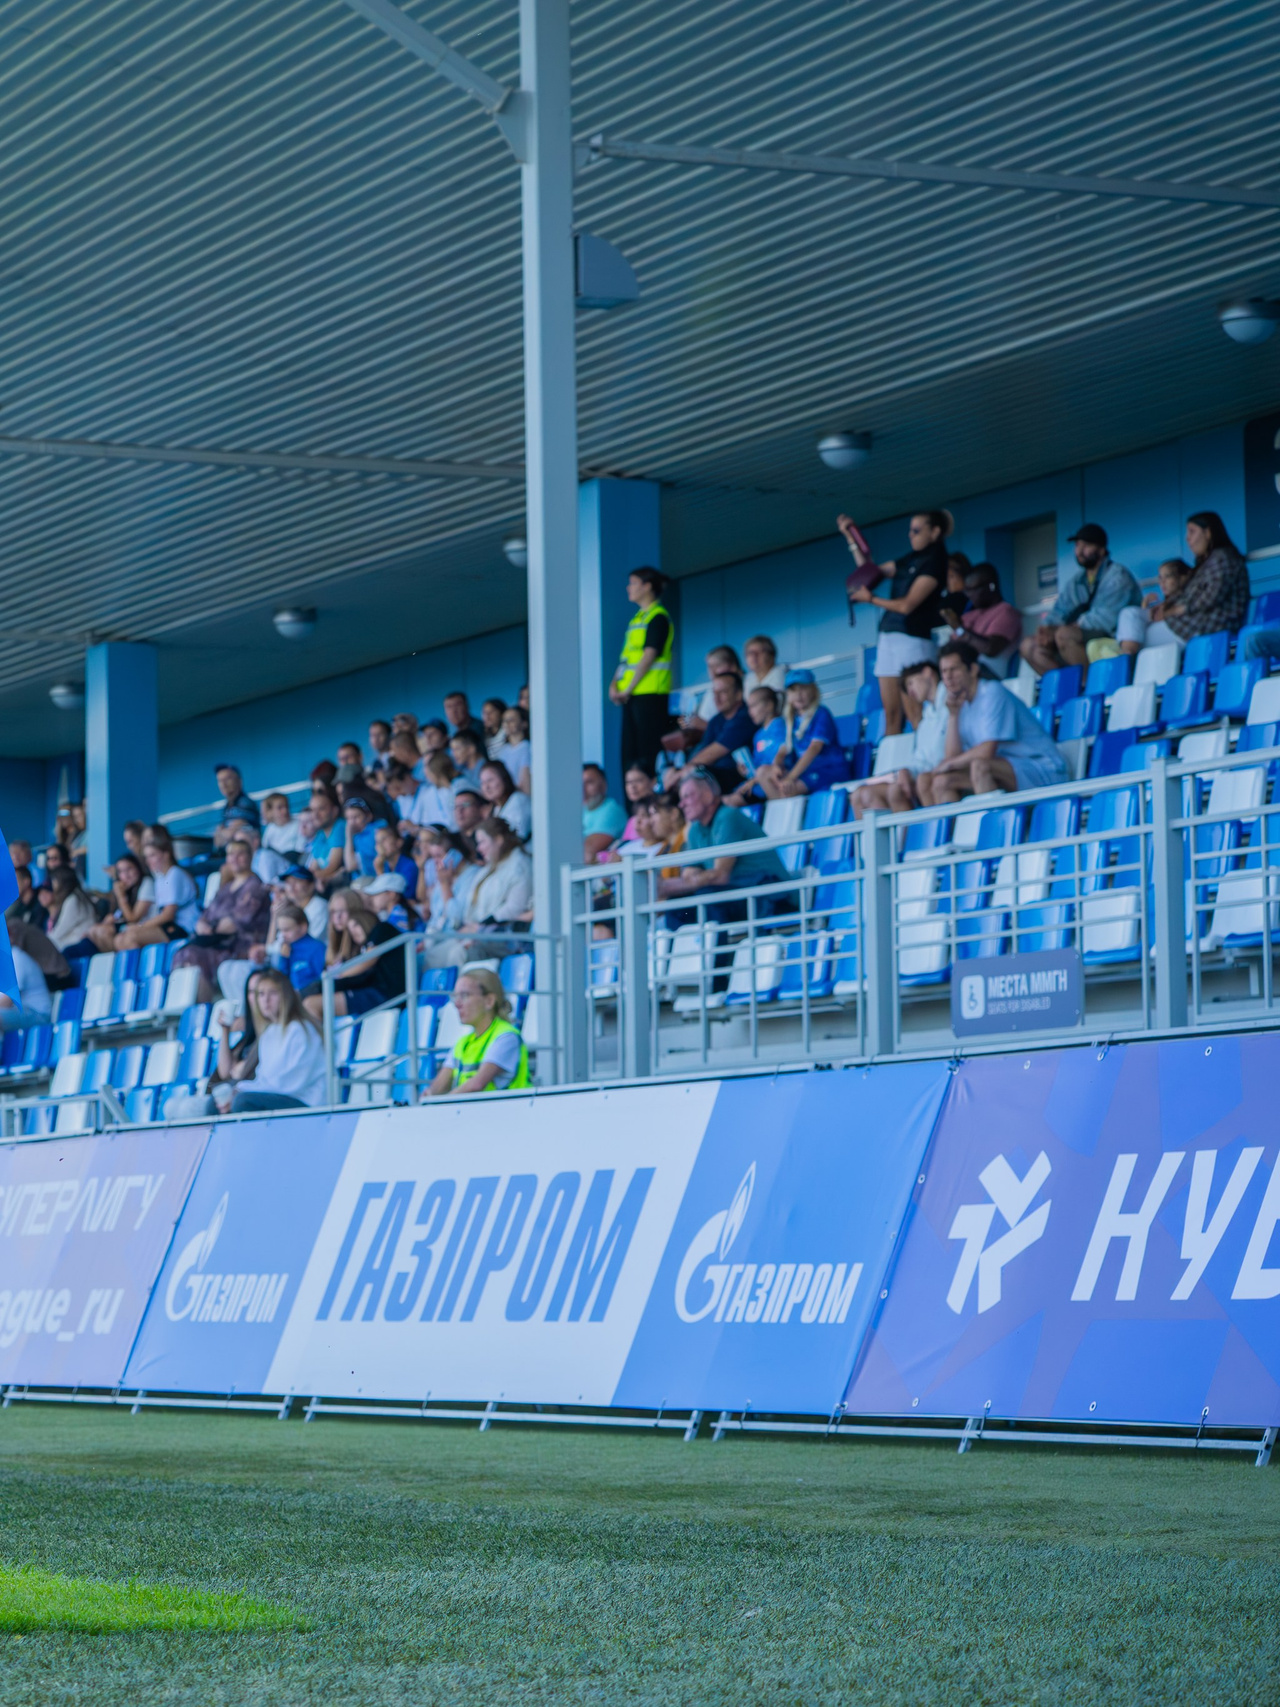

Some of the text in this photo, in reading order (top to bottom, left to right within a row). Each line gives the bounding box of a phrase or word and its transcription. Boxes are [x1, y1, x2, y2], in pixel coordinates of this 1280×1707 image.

[987, 973, 1029, 999] МЕСТА
[315, 1167, 656, 1323] ГАЗПРОМ
[190, 1272, 289, 1323] ГАЗПРОМ
[713, 1262, 864, 1324] ГАЗПРОМ
